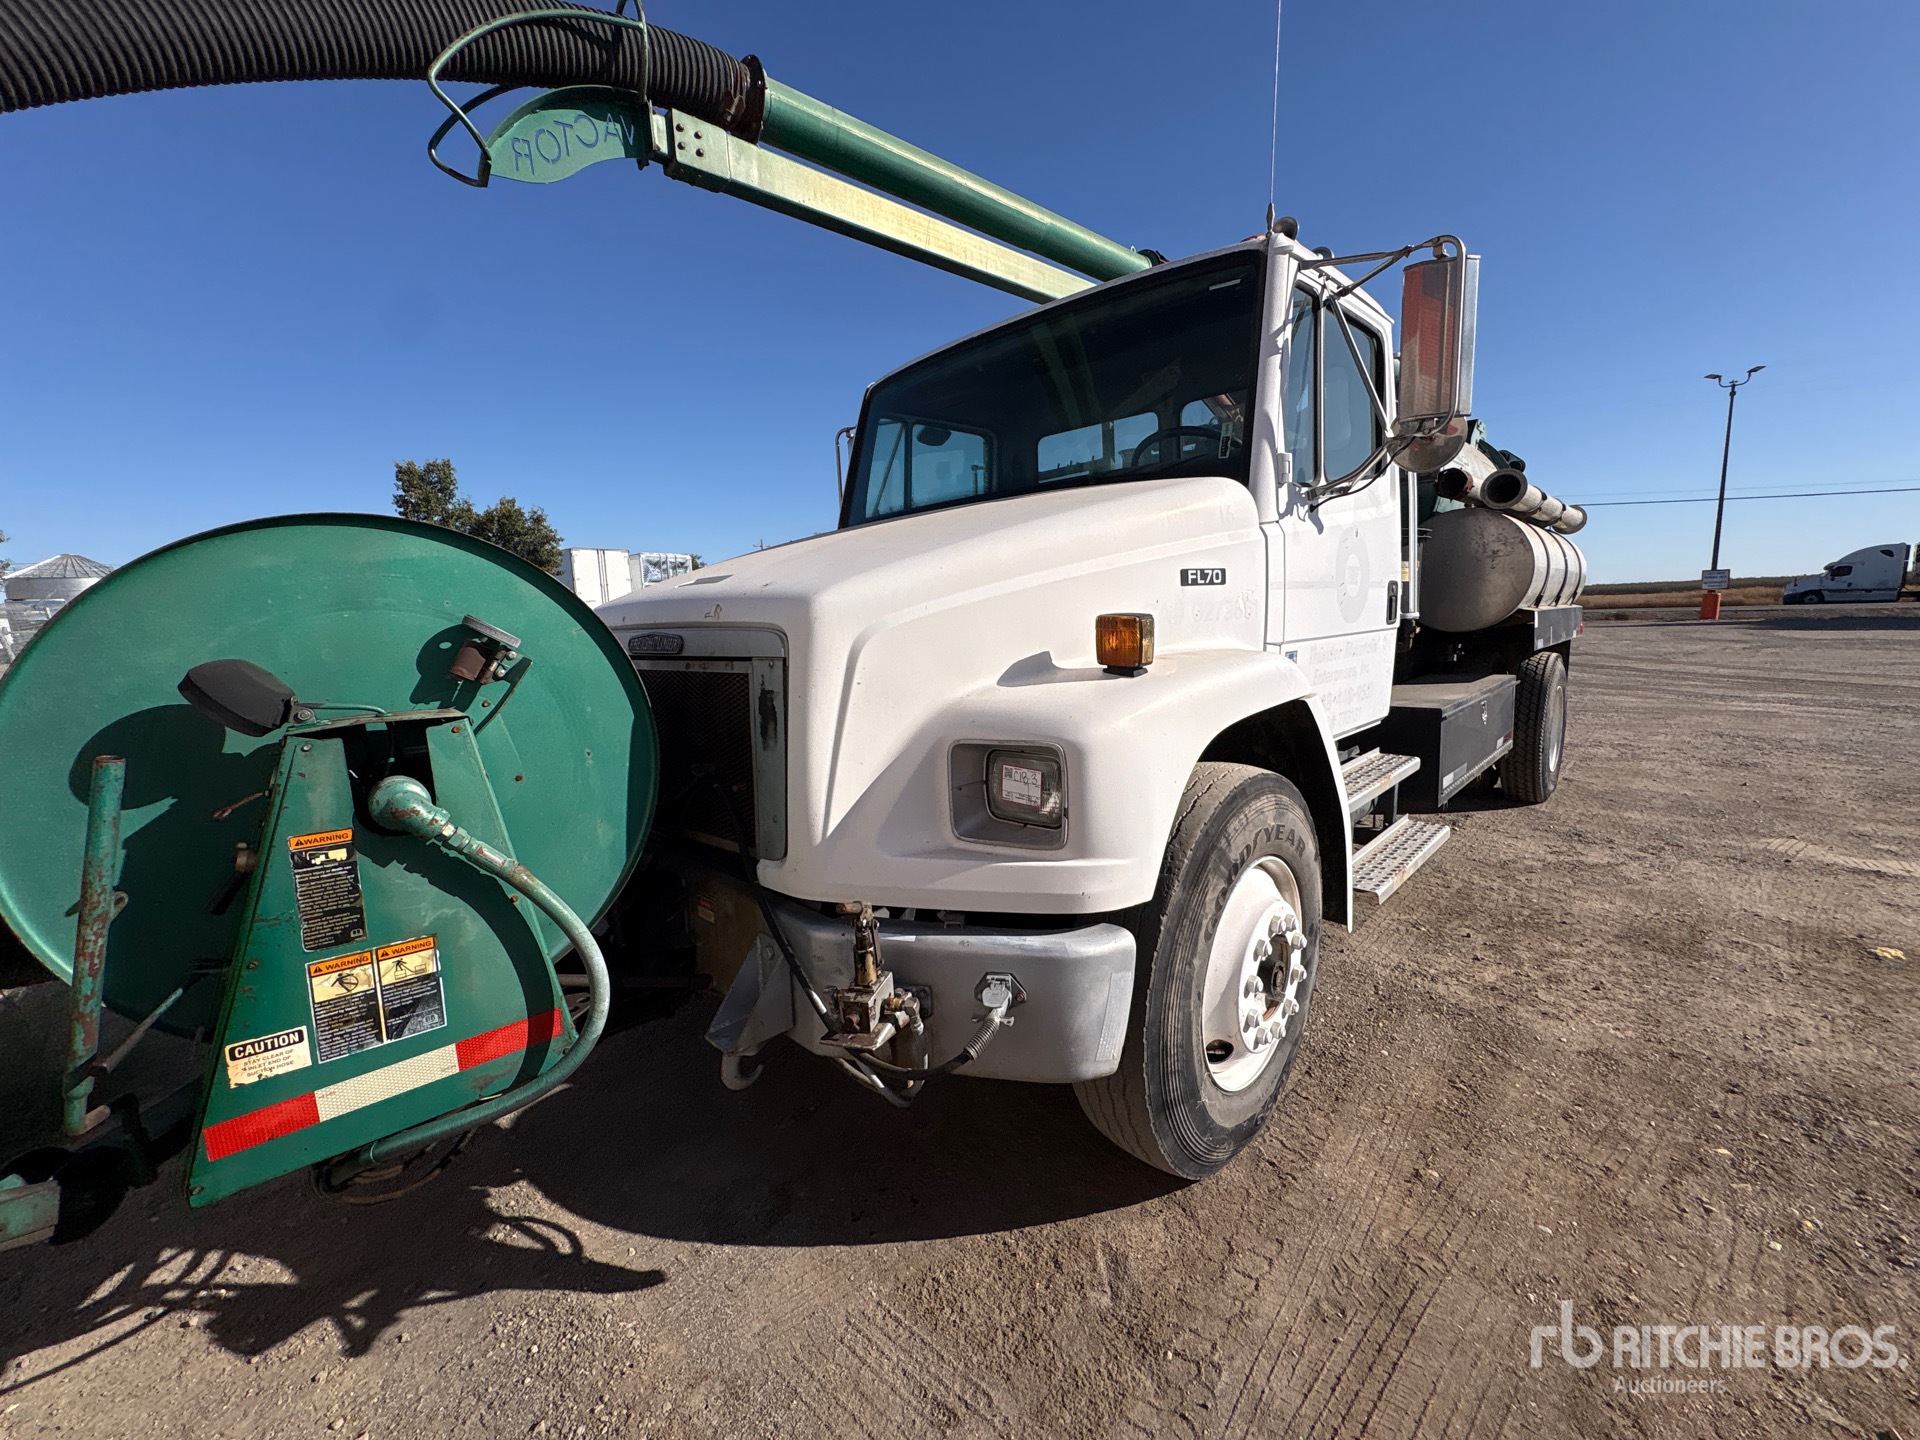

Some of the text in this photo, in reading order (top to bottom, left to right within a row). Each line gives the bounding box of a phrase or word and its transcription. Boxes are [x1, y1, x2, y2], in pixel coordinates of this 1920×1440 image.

[1187, 569, 1222, 584] FL70
[303, 832, 349, 845] WARNING
[391, 940, 432, 955] WARNING
[325, 955, 369, 970] WARNING
[234, 1032, 300, 1058] CAUTION
[243, 1057, 261, 1066] STAY
[262, 1051, 285, 1061] CLEAR
